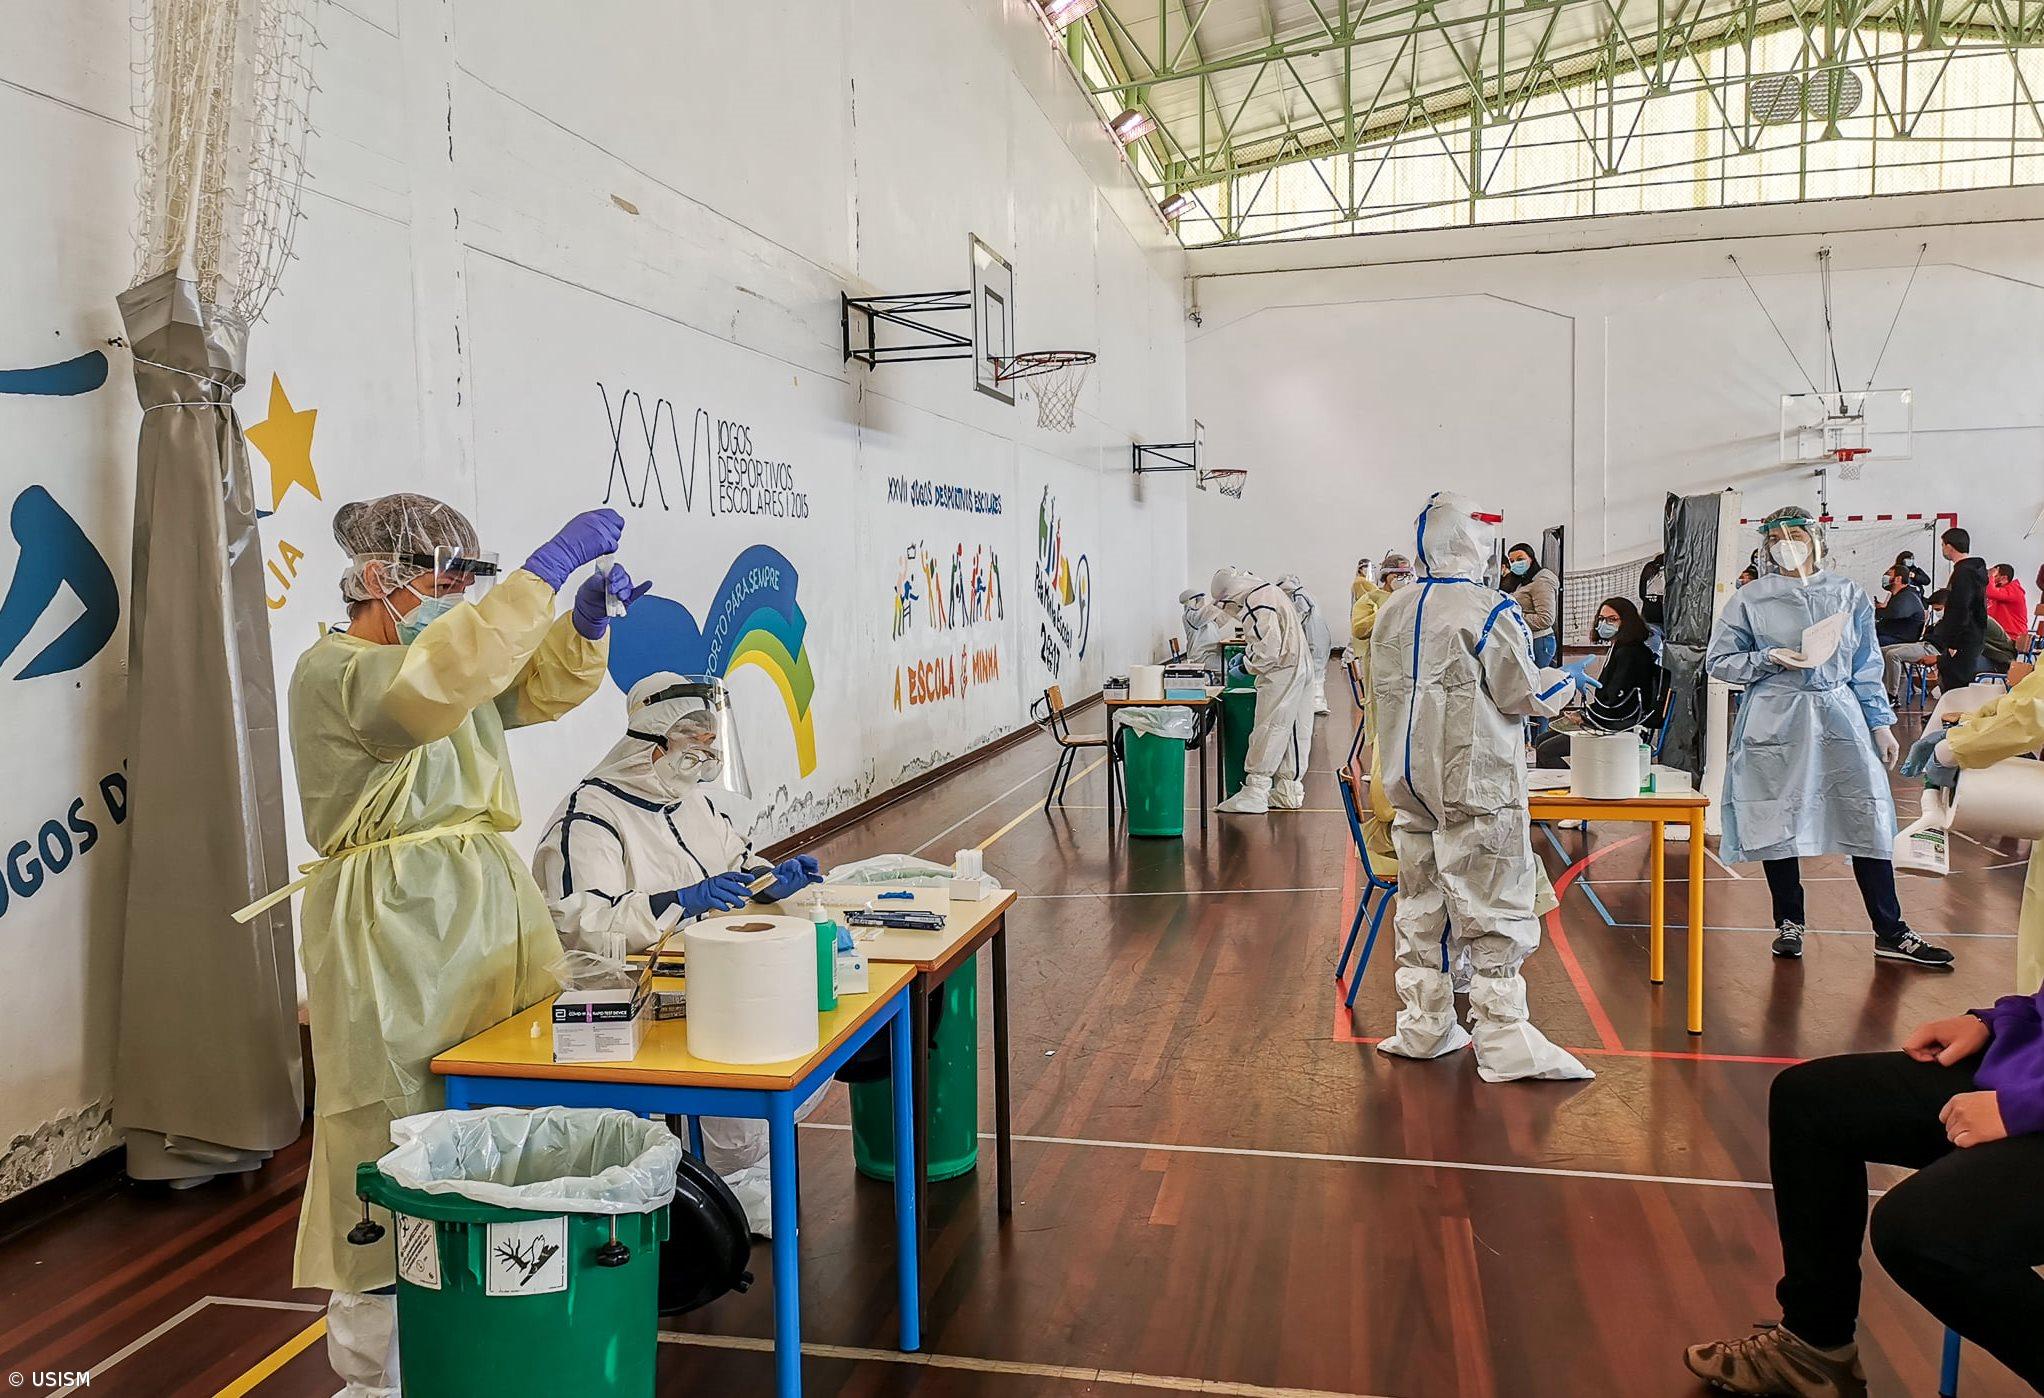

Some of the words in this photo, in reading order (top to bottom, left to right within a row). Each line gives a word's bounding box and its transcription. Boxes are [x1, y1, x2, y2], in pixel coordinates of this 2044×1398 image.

[597, 382, 716, 517] XXVI
[717, 419, 753, 456] JOGOS
[718, 455, 794, 491] DESPORTIVOS
[719, 485, 784, 518] ESCOLARES
[791, 491, 809, 519] 2015
[911, 479, 933, 508] JOGOS
[725, 577, 750, 622] PARA
[749, 565, 780, 592] SEMPRE
[893, 665, 902, 714] A
[908, 654, 955, 706] ESCOLA
[972, 643, 999, 686] MINHA
